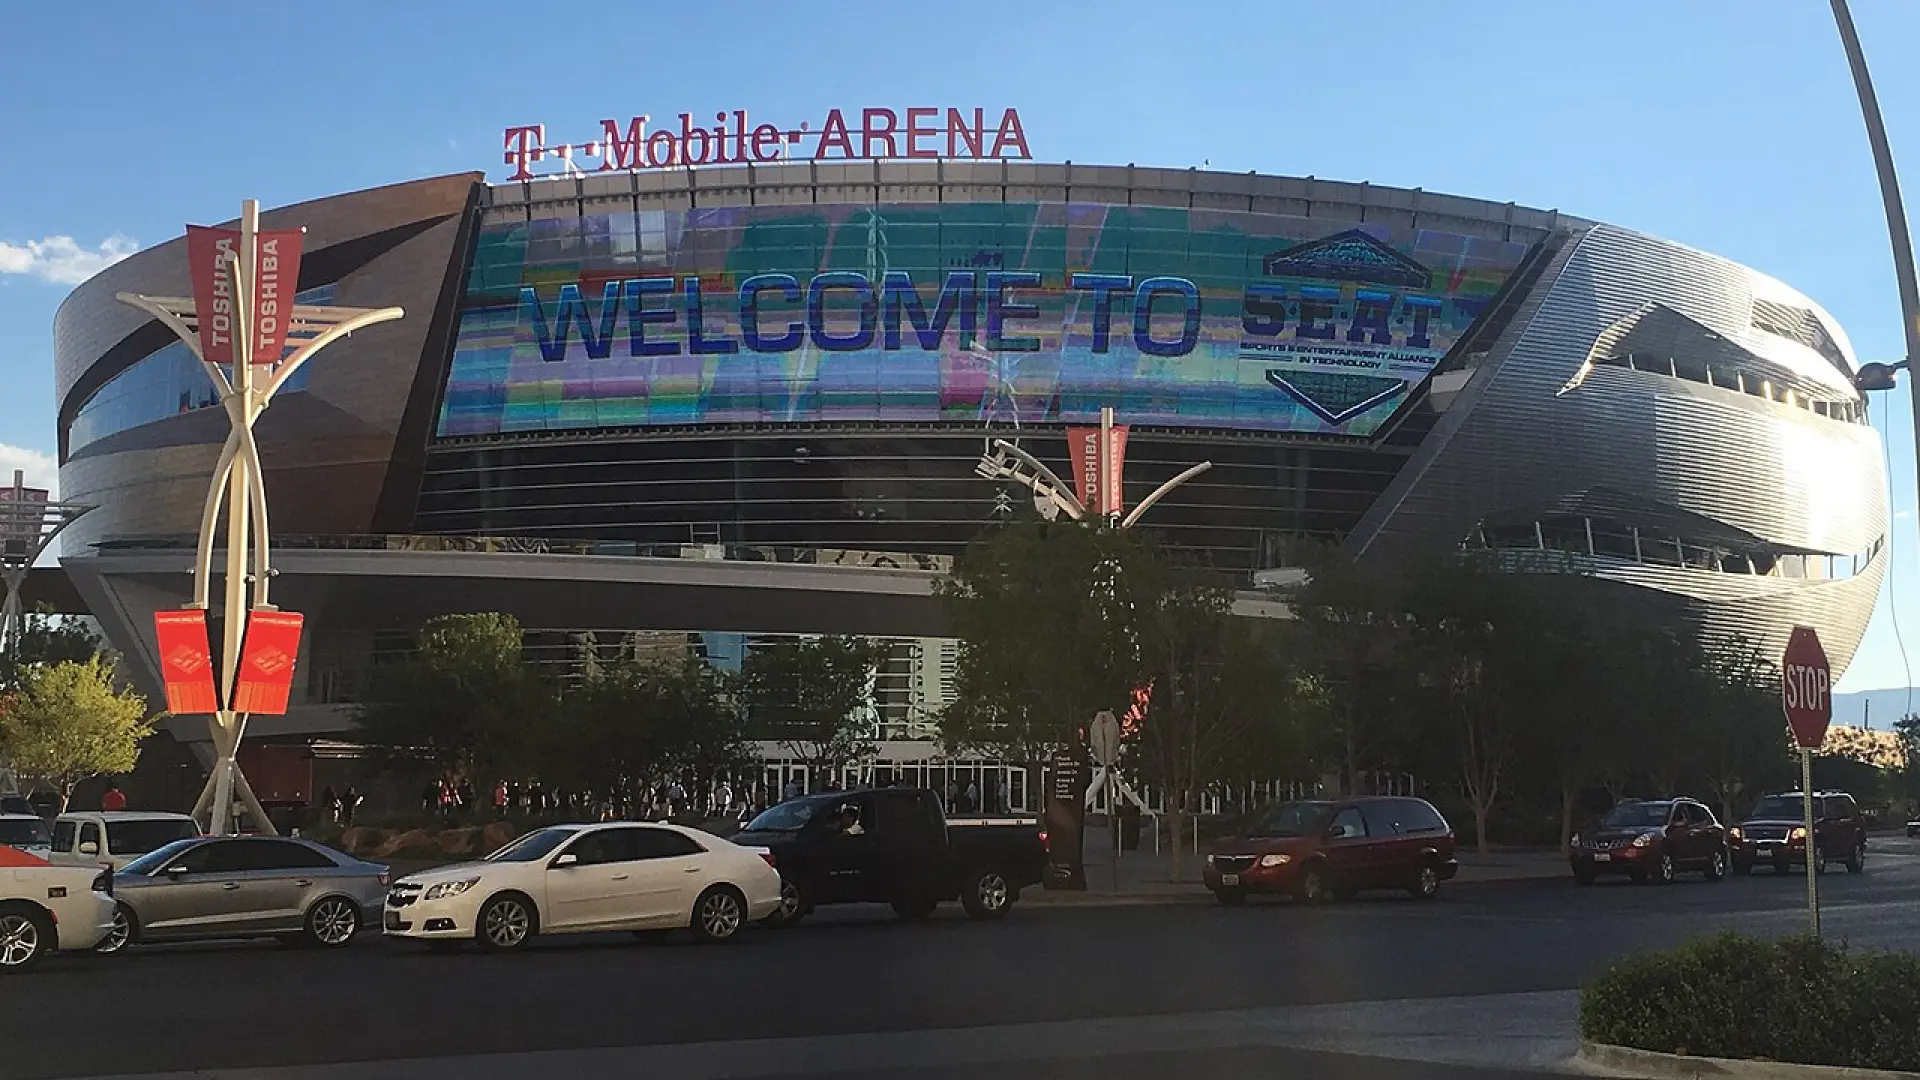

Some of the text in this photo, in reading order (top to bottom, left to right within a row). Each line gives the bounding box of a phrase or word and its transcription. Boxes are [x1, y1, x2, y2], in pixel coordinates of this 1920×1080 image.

[815, 107, 1033, 160] ARENA
[212, 237, 233, 348] TOSHIBA
[259, 238, 279, 349] TOSHIBA
[519, 271, 1203, 363] WELCOME TO
[1240, 342, 1288, 352] SPORTS
[1296, 346, 1387, 360] ENTERTAINMENT
[1388, 352, 1437, 364] ALLIANCE
[1298, 356, 1382, 369] IN TECHNOLOGY
[1786, 663, 1828, 711] STOP
